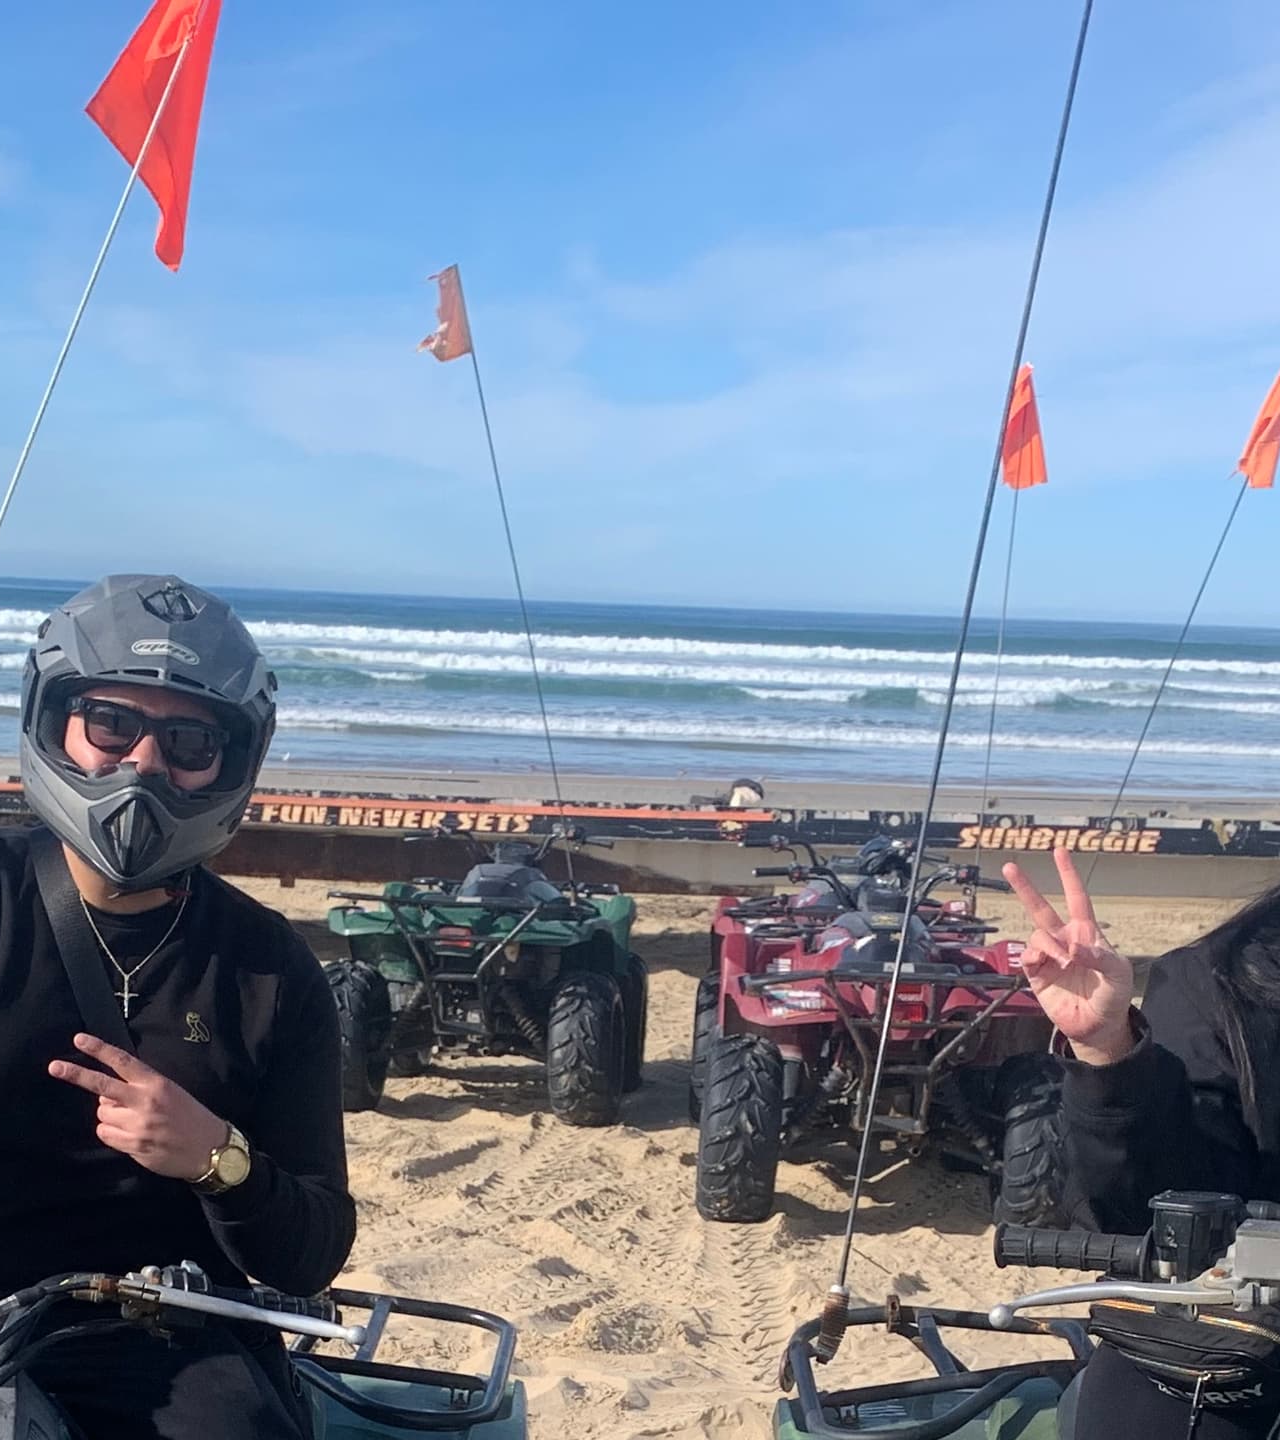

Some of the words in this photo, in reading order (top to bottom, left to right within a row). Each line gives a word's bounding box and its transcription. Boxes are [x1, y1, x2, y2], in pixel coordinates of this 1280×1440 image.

[260, 804, 329, 826] FUN
[338, 807, 446, 831] NEVER
[456, 812, 534, 833] SETS
